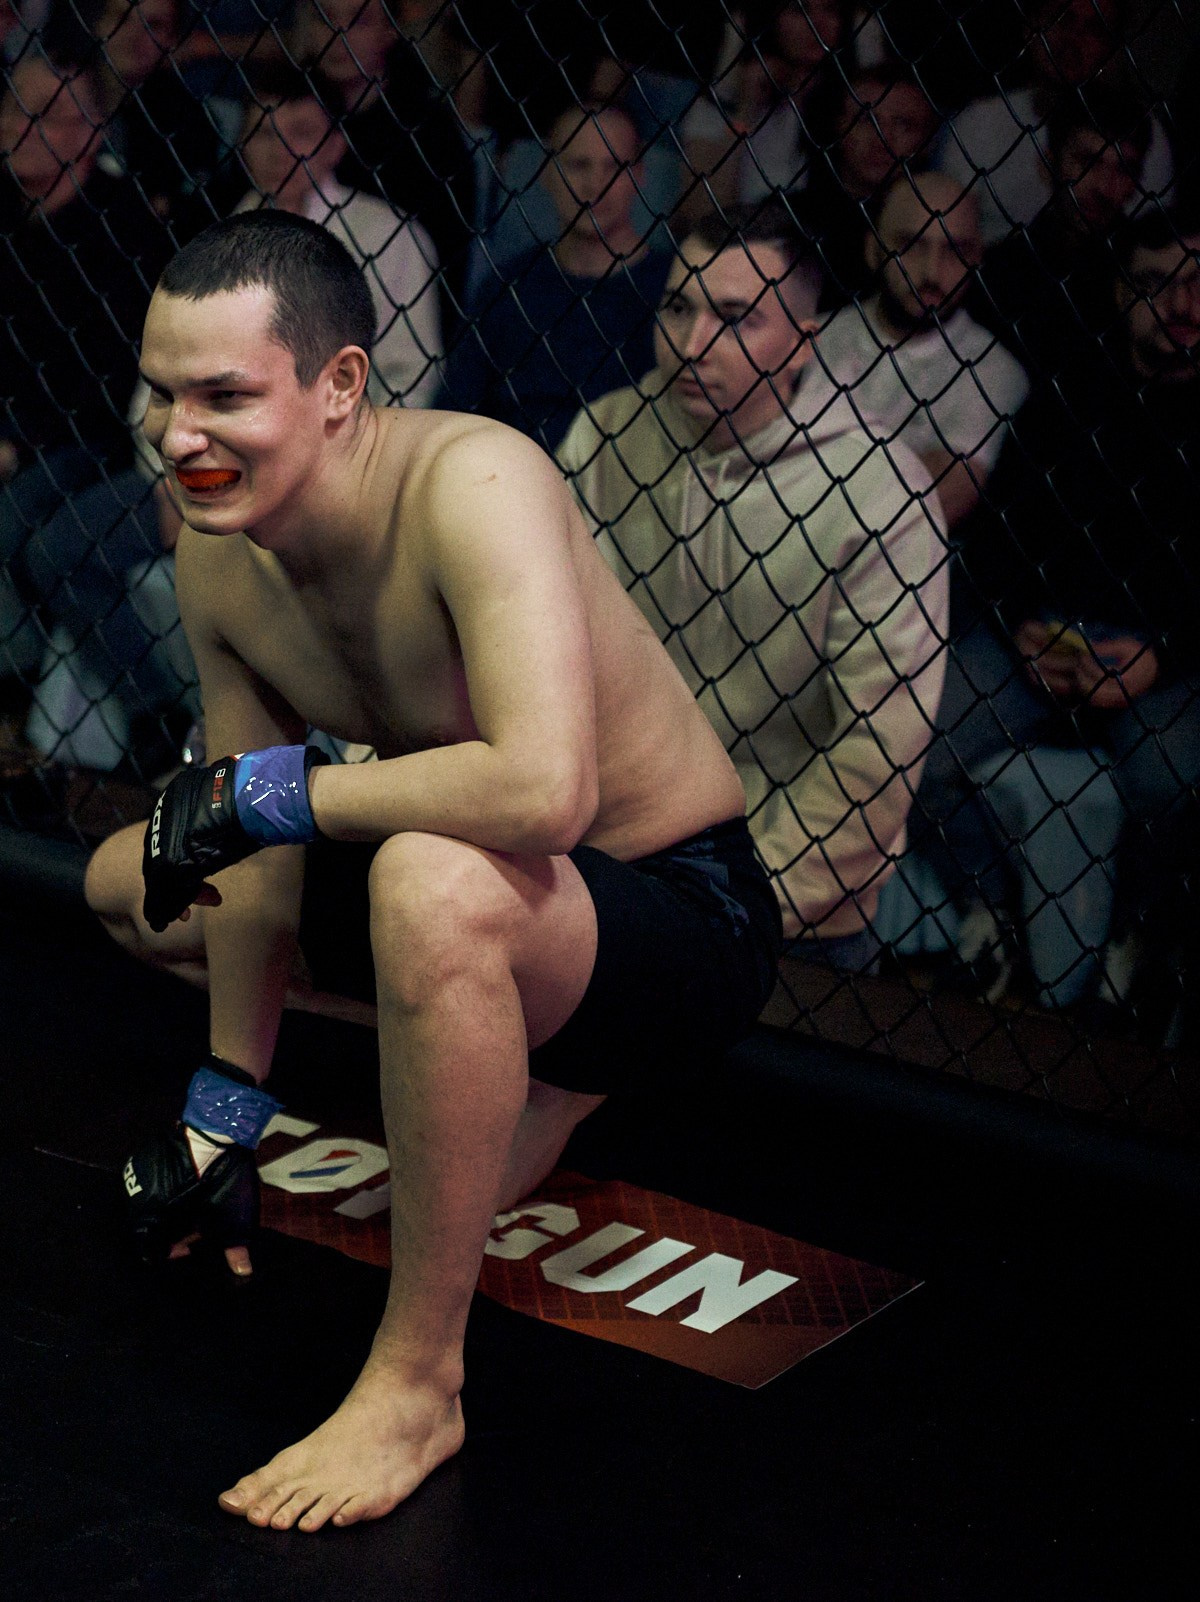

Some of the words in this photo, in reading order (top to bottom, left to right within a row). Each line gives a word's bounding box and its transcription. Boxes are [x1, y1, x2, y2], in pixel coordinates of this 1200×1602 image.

[151, 790, 166, 859] RDX
[122, 1155, 144, 1198] RD
[257, 1112, 800, 1334] OGUN
